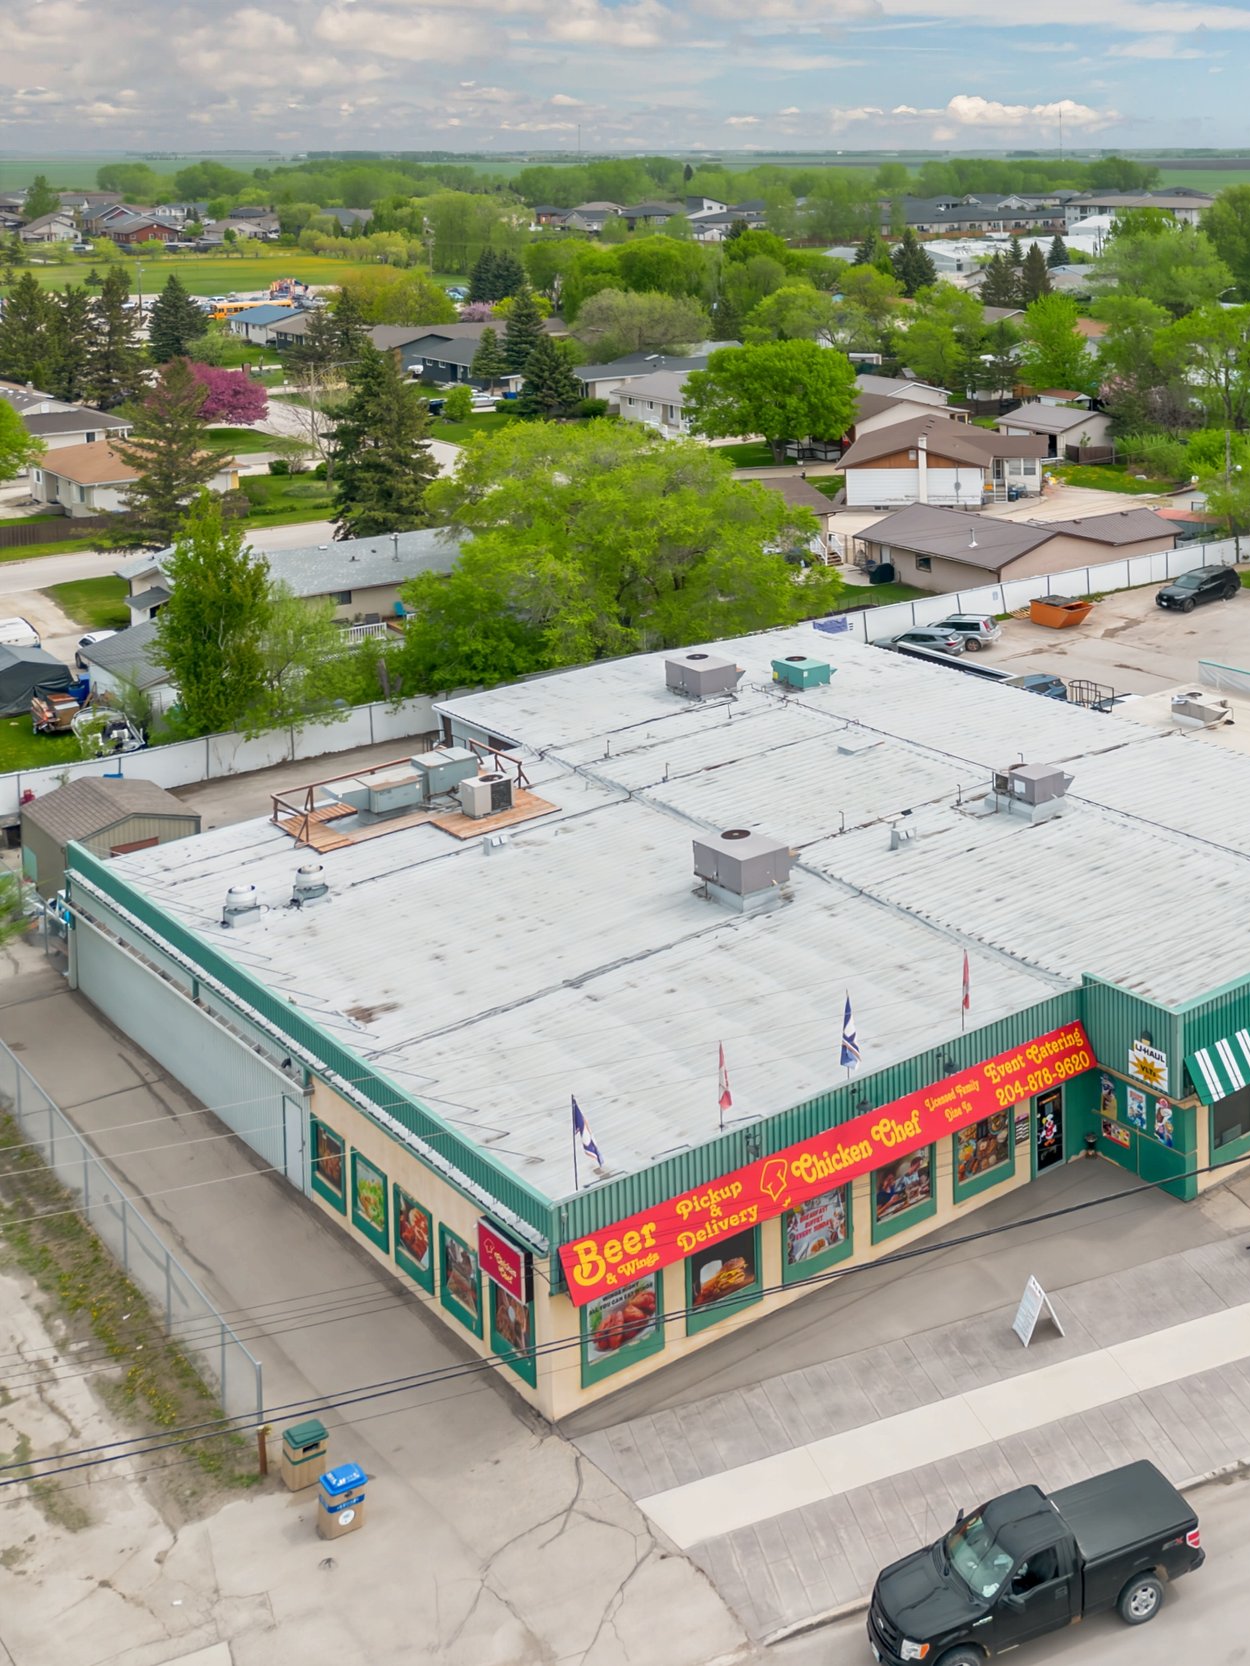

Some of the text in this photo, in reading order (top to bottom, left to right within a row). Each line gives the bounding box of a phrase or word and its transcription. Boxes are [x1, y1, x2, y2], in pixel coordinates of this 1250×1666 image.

[983, 1027, 1084, 1085] Event Catering
[1135, 1042, 1165, 1063] U-HAUL
[924, 1079, 980, 1112] Licensed Family
[996, 1050, 1090, 1107] 204-878-9620
[944, 1104, 963, 1123] Dine
[790, 1109, 922, 1184] Chicken Chef
[675, 1180, 743, 1221] Pickup
[709, 1203, 723, 1218] &
[676, 1203, 759, 1253] Delivery
[573, 1221, 657, 1287] Beer
[606, 1251, 660, 1286] & Wings
